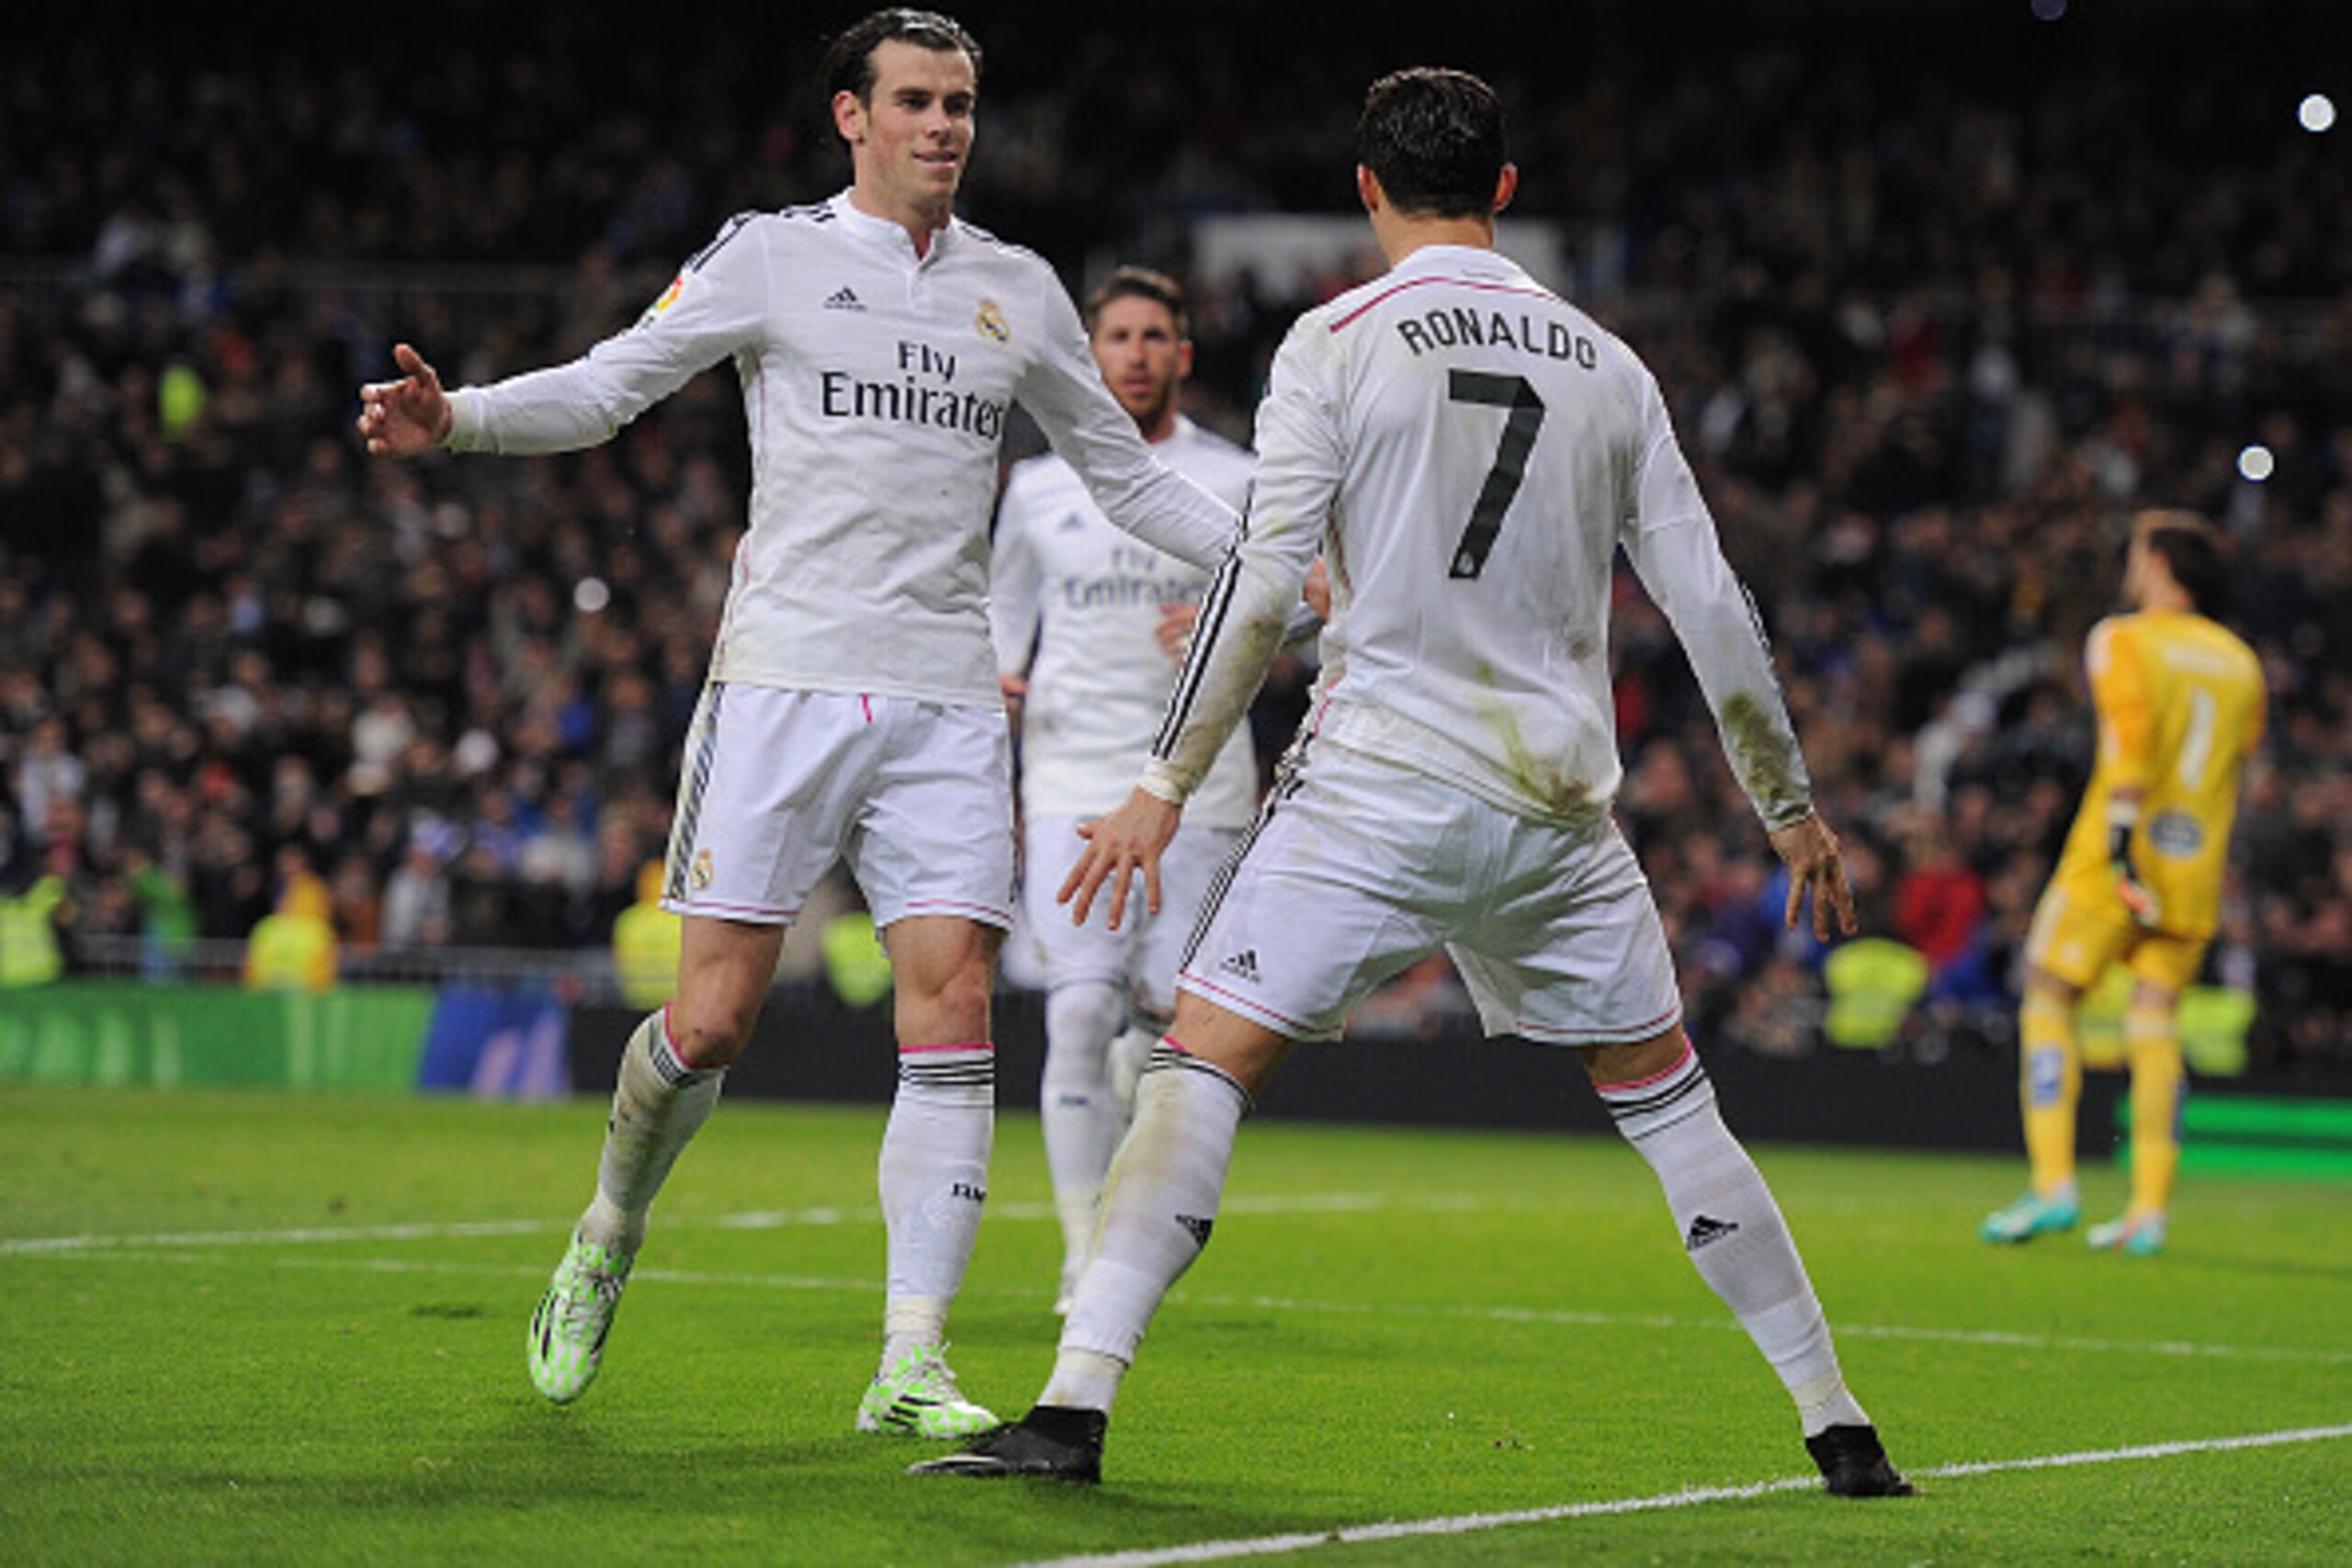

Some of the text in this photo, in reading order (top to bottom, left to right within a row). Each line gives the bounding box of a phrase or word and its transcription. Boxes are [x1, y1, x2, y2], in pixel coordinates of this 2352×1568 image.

[897, 340, 956, 384] Fly
[1396, 307, 1598, 370] RONALDO
[820, 371, 1003, 442] Emirates
[1448, 368, 1546, 580] 7
[2179, 687, 2217, 791] 1
